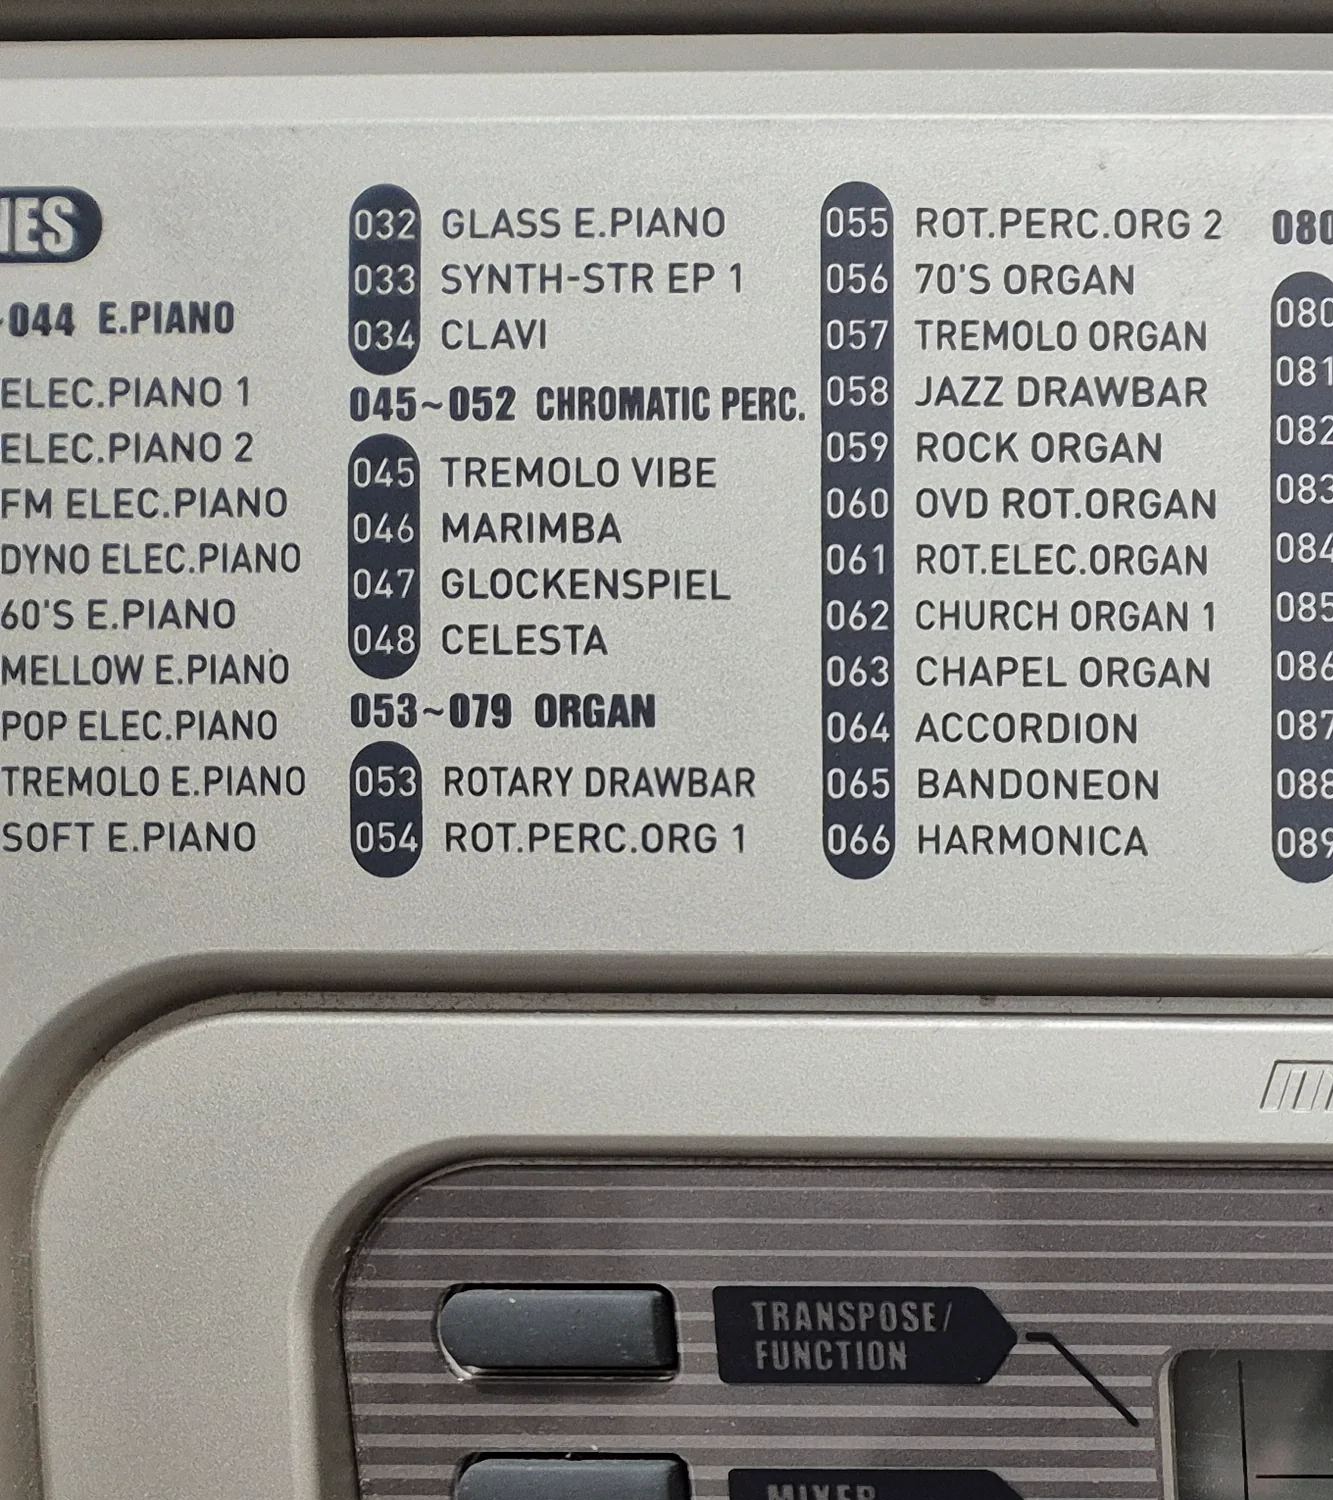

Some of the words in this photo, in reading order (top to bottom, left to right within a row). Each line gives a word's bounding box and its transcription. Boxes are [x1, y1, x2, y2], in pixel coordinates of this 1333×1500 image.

[354, 208, 416, 240] 032
[442, 207, 561, 240] GLASS
[574, 206, 725, 239] E.PIANO
[826, 206, 888, 238] 055
[916, 207, 1190, 240] ROT.PERC.ORG
[1204, 208, 1222, 240] 2
[0, 302, 76, 338] 044
[99, 301, 235, 335] E.PIANO
[1275, 355, 1333, 387] 081
[349, 385, 516, 422] 045~052
[536, 386, 710, 422] CHROMATIC
[721, 386, 805, 422] PERC.
[353, 568, 415, 600] 047
[441, 567, 731, 601] GLOCKENSPIEL
[350, 692, 512, 729] 053~079
[534, 693, 656, 729] ORGAN
[355, 765, 417, 797] 053
[444, 766, 573, 797] ROTARY
[585, 766, 755, 798] DRAWBAR
[2, 821, 95, 853] SOFT
[108, 821, 256, 853] E.PIANO
[827, 823, 890, 855] 066
[918, 824, 1148, 857] HARMONICA
[752, 1301, 952, 1332] TRANSPOSE/
[755, 1340, 907, 1371] FUNCTION
